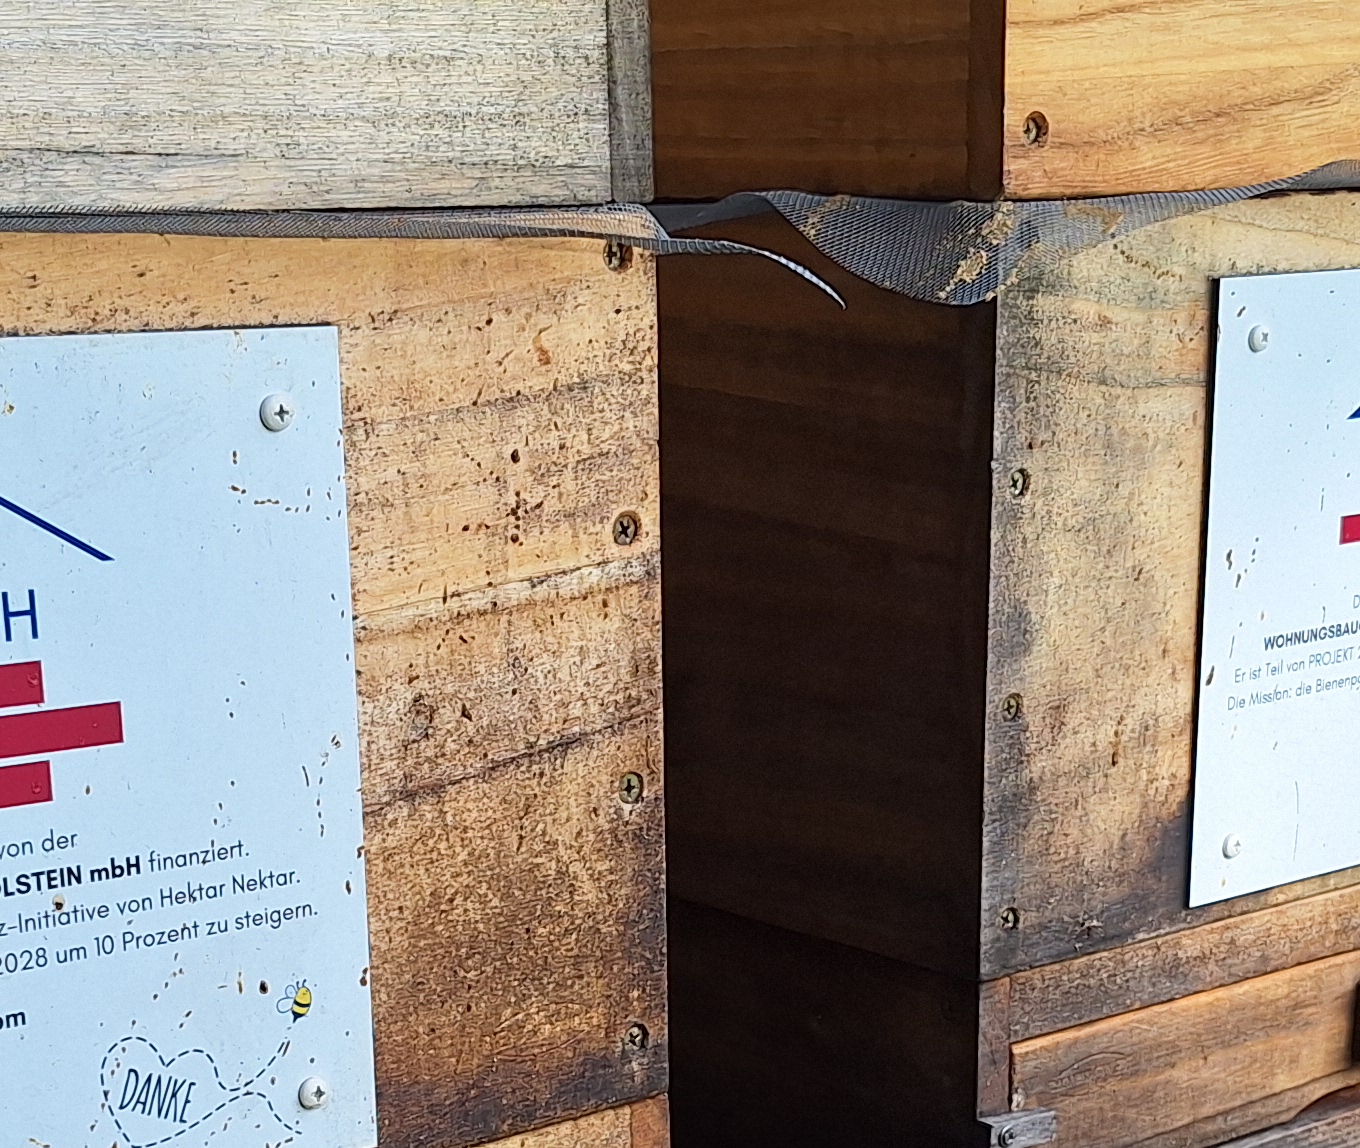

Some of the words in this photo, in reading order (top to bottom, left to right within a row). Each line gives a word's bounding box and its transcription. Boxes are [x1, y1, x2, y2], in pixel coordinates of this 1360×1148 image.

[1234, 668, 1247, 684] Er
[1249, 666, 1261, 682] ist
[1264, 659, 1282, 677] Teil
[1287, 659, 1305, 672] von
[1309, 646, 1354, 669] PROJEKT
[1228, 696, 1246, 711] Die
[1295, 681, 1312, 696] die
[42, 829, 77, 853] der
[90, 856, 141, 883] mbH
[148, 839, 249, 873] finanziert.
[117, 896, 153, 916] von
[159, 881, 225, 908] Hektar
[232, 867, 301, 894] Nektar.
[55, 945, 87, 963] um
[93, 934, 115, 956] 10
[123, 923, 199, 952] Prozent
[206, 915, 229, 936] zu
[235, 904, 318, 932] steigern.
[118, 1068, 196, 1124] DANKE
